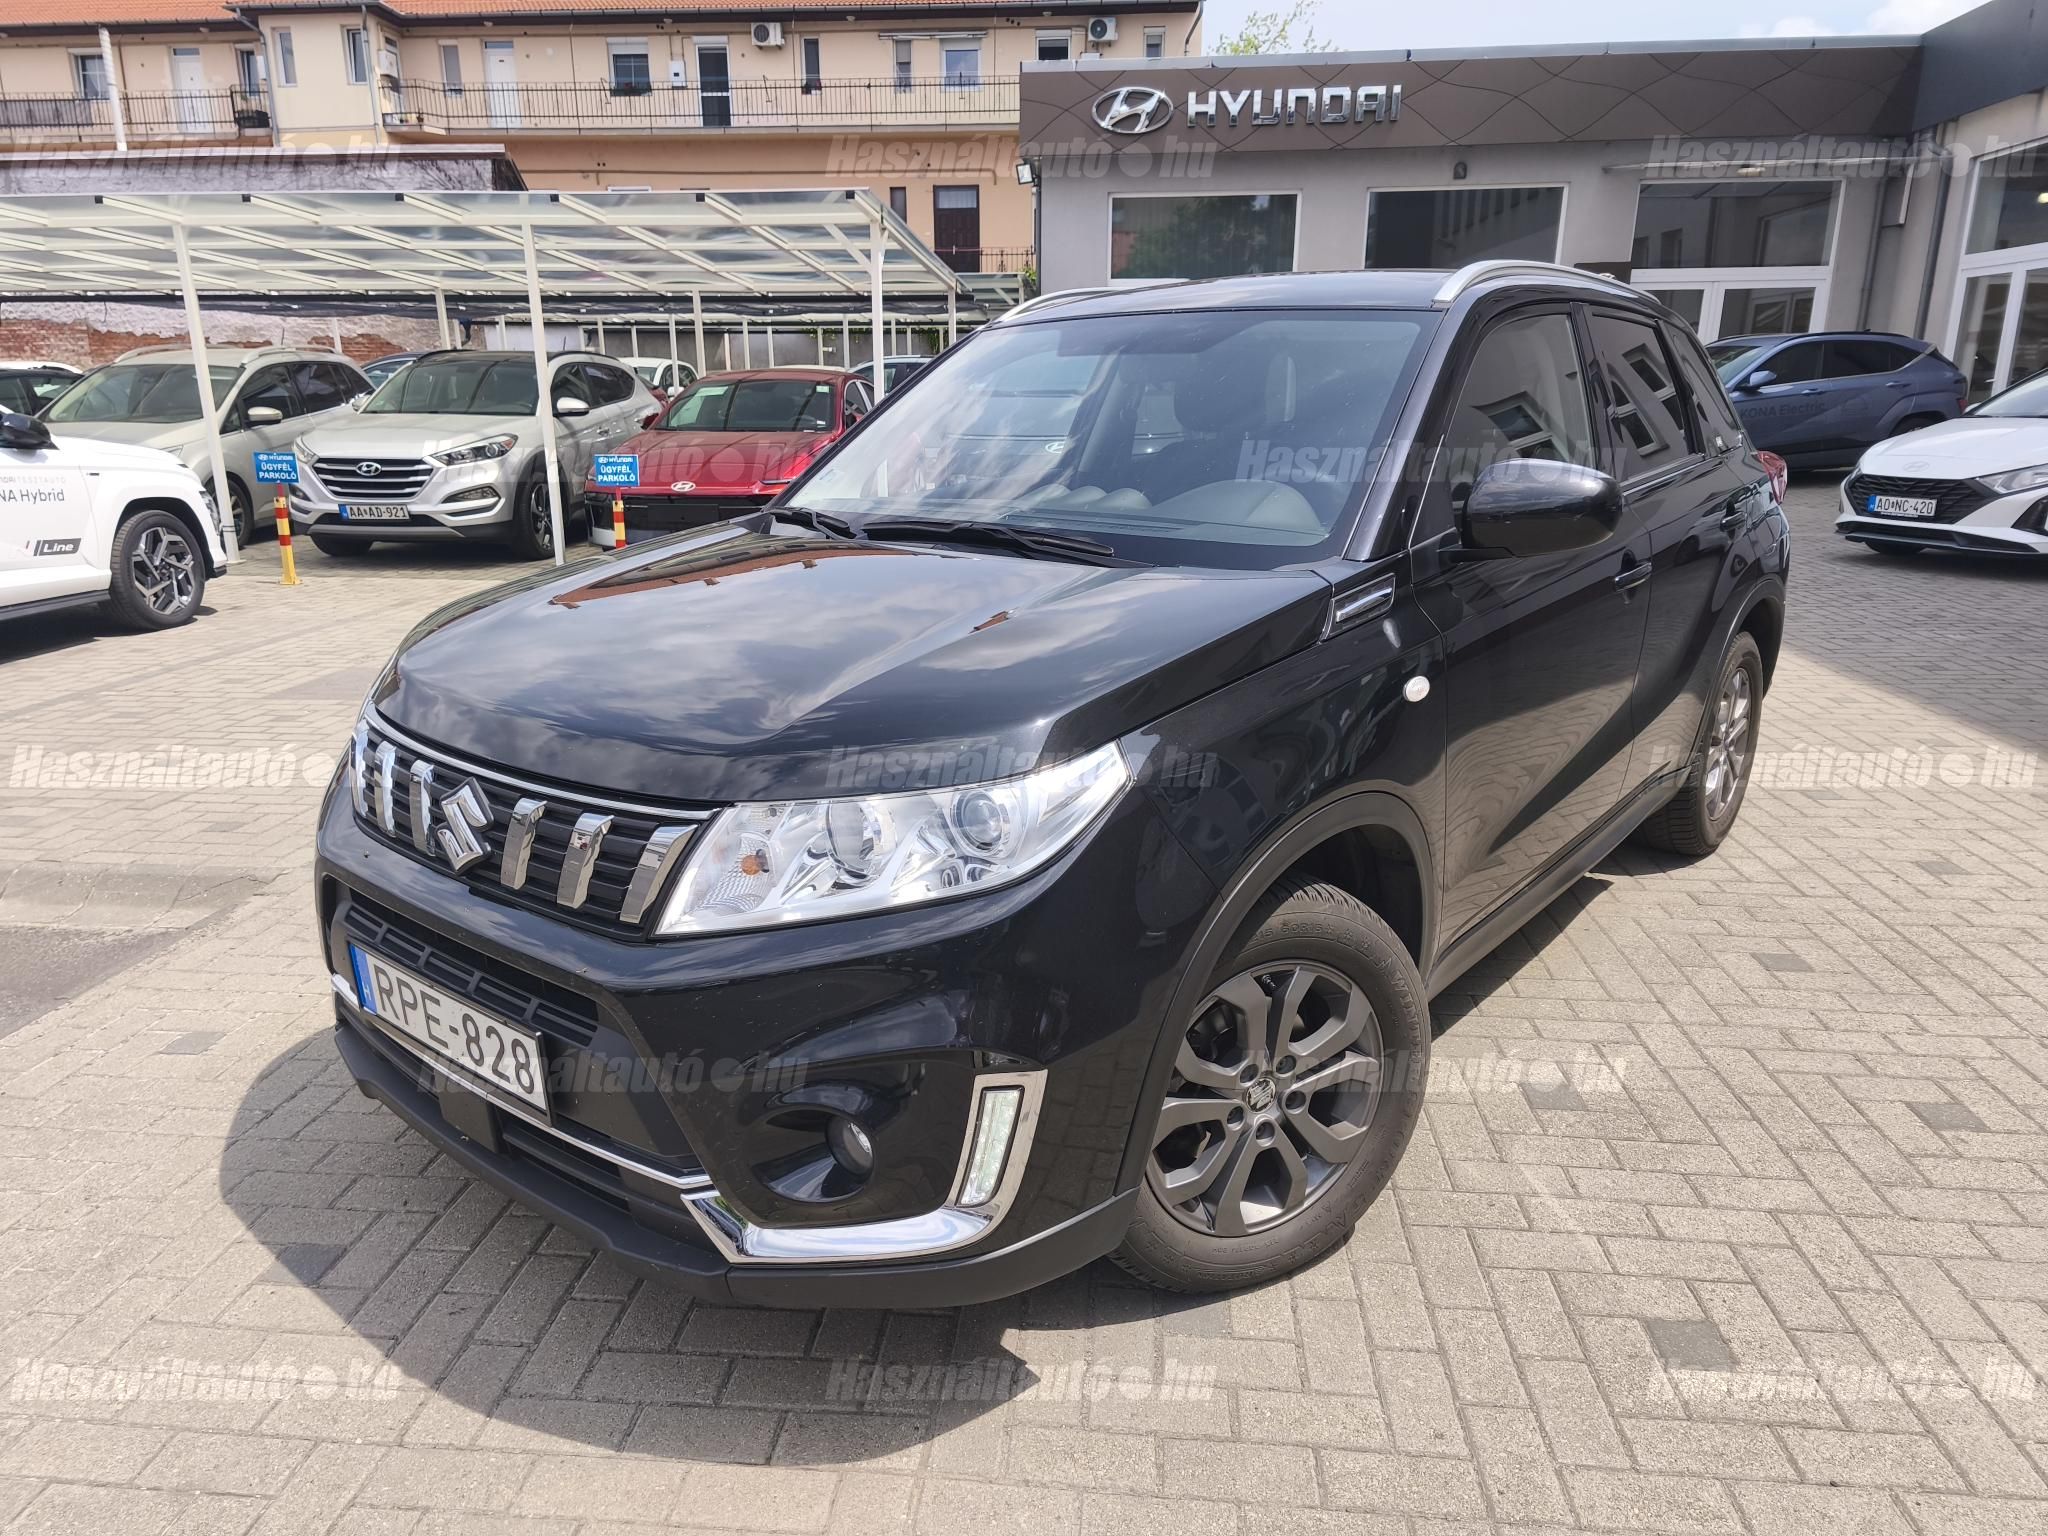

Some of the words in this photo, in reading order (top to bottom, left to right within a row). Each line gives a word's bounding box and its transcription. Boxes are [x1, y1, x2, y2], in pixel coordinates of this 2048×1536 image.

[1187, 84, 1402, 127] HYUNDAI
[261, 462, 292, 471] ÜGYFÉL
[601, 465, 631, 473] ÜGYFÉL
[259, 471, 296, 480] PARKOLÓ
[598, 474, 635, 482] PARKOLÓ
[20, 488, 64, 504] Hybrid
[43, 542, 74, 552] Line
[374, 965, 535, 1095] RPE-828
